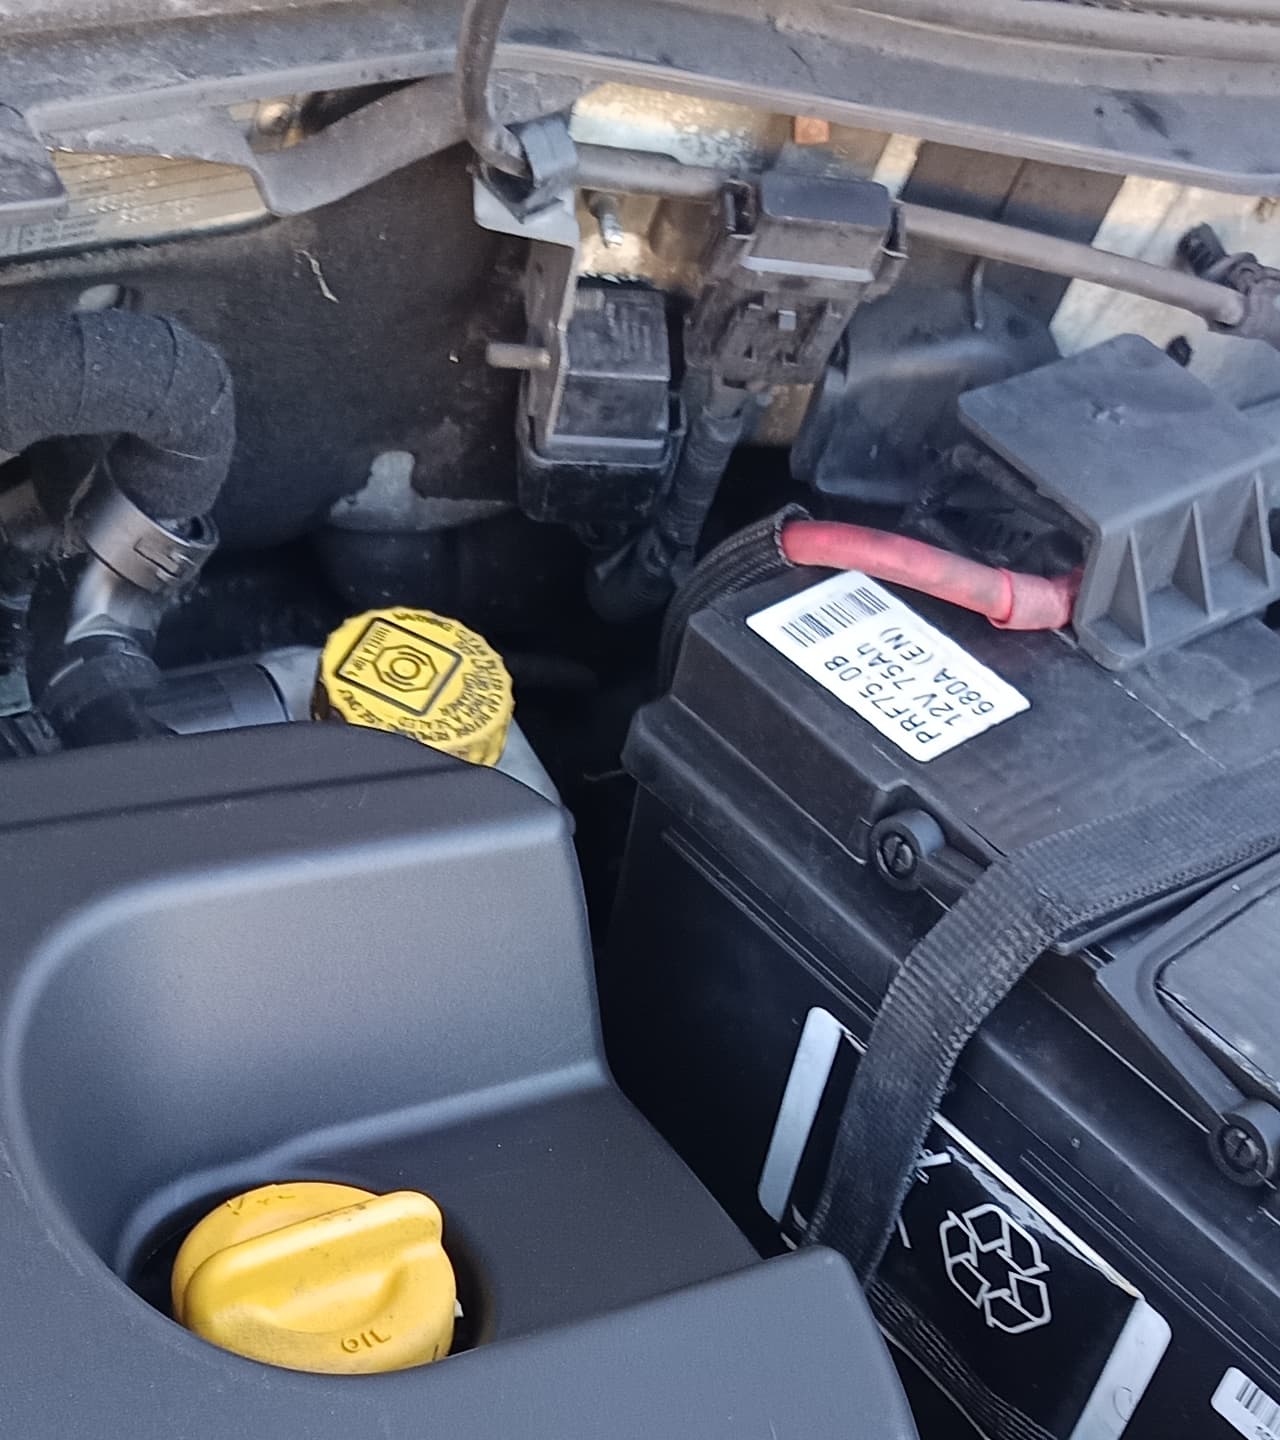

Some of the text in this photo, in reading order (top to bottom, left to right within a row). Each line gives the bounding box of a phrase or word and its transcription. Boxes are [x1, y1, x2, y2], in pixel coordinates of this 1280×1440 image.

[856, 640, 968, 728] 12V 75Ah
[878, 626, 996, 714] 680A (EN)
[340, 1328, 393, 1353] OIL
